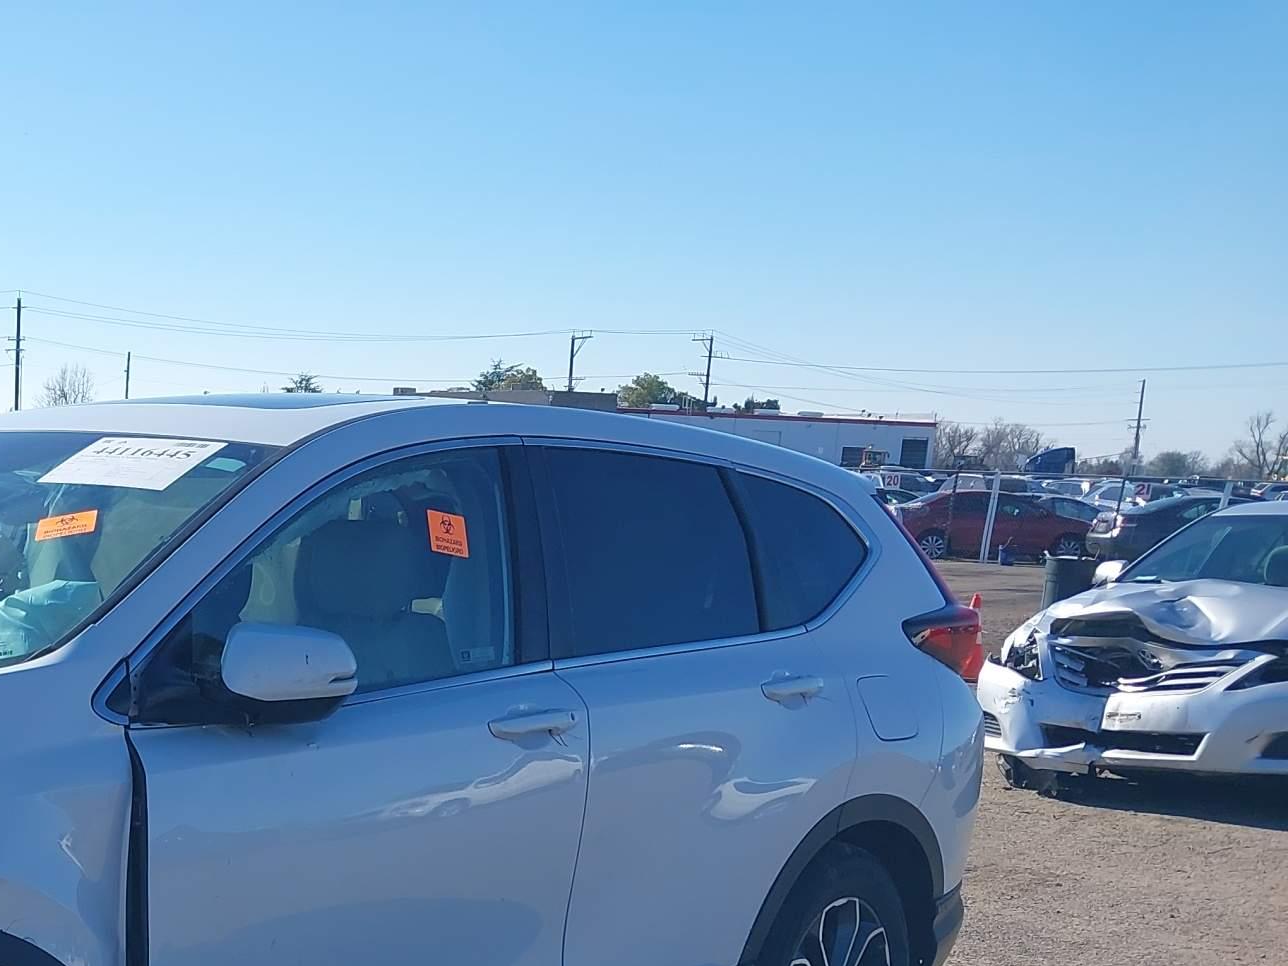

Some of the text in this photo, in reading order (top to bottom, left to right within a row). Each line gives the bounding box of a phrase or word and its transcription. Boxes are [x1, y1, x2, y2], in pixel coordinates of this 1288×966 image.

[92, 446, 197, 459] 44116445
[886, 475, 899, 487] 20
[1135, 483, 1151, 496] 21
